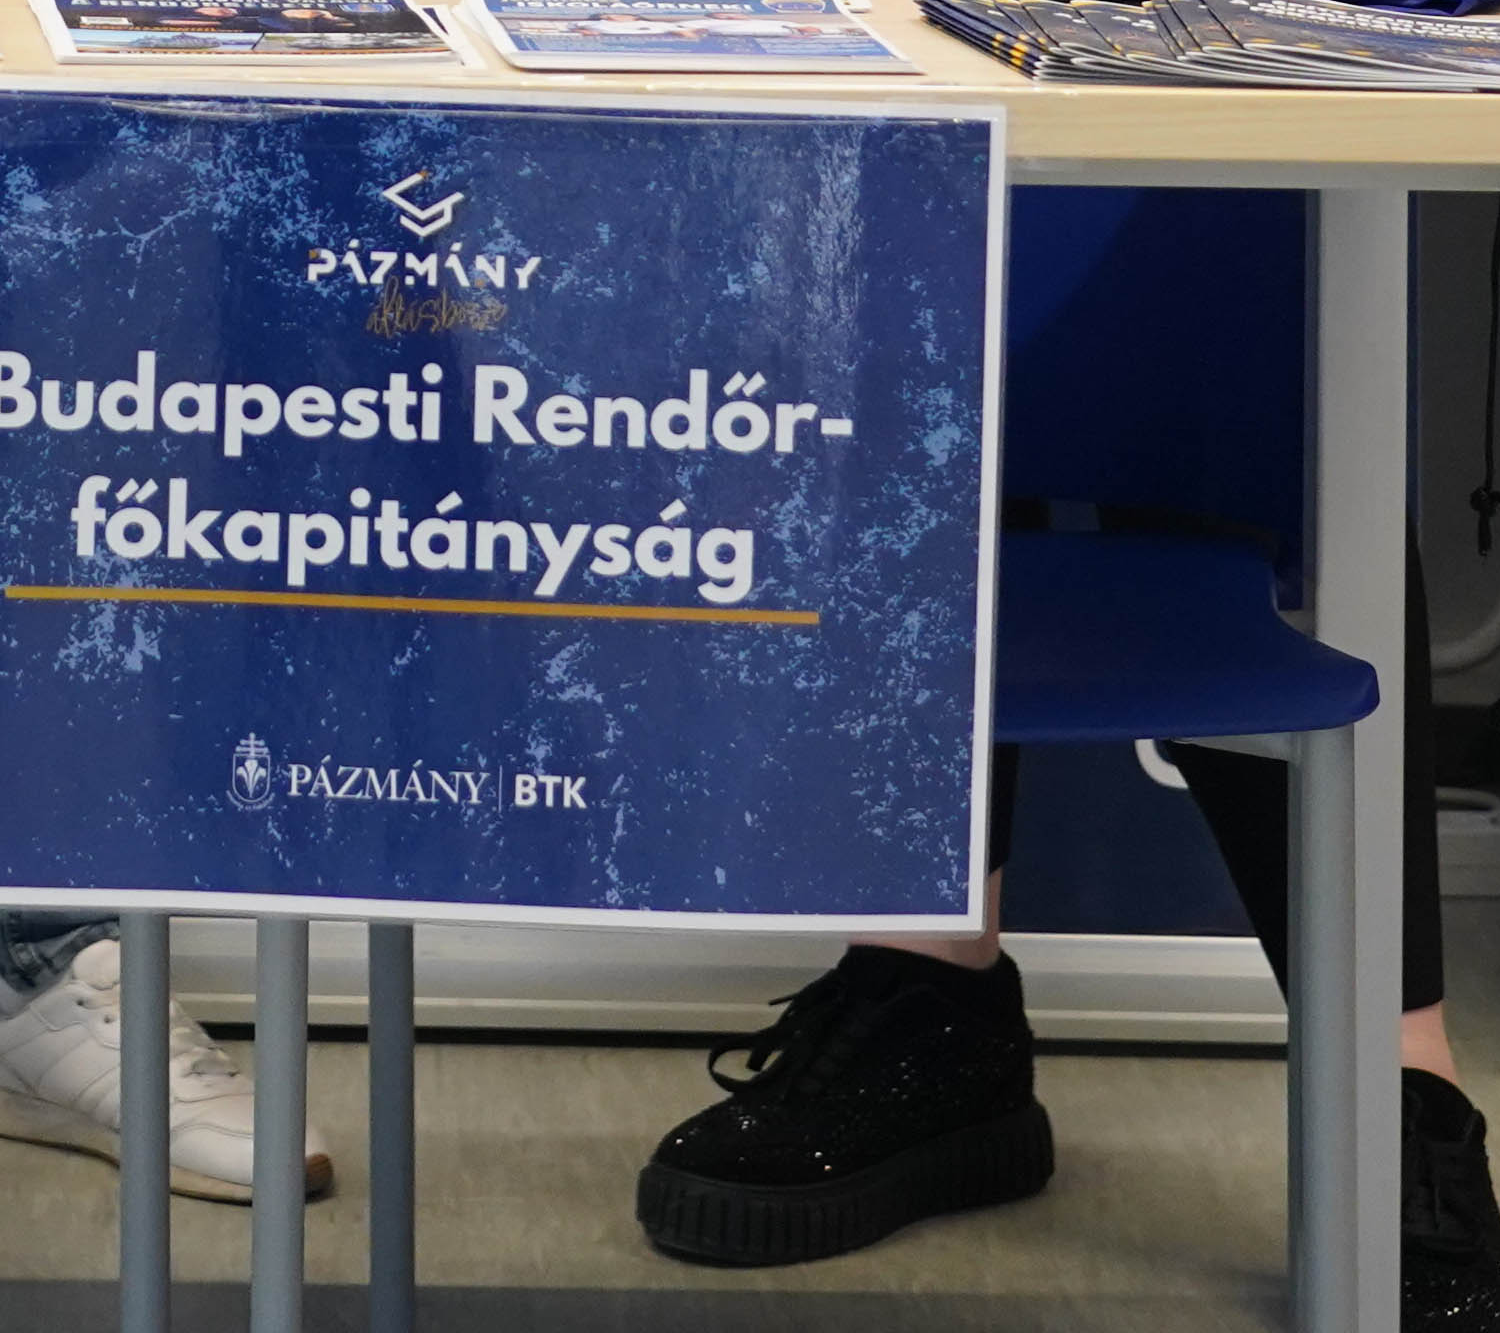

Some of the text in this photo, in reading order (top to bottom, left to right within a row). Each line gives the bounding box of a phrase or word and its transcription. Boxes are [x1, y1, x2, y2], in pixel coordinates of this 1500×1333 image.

[307, 238, 542, 290] PÁZMÁNY
[473, 364, 854, 454] Rendőr-
[70, 475, 754, 604] főkapitányság
[287, 754, 491, 805] PÁZMÁNY
[514, 774, 587, 809] BTK
